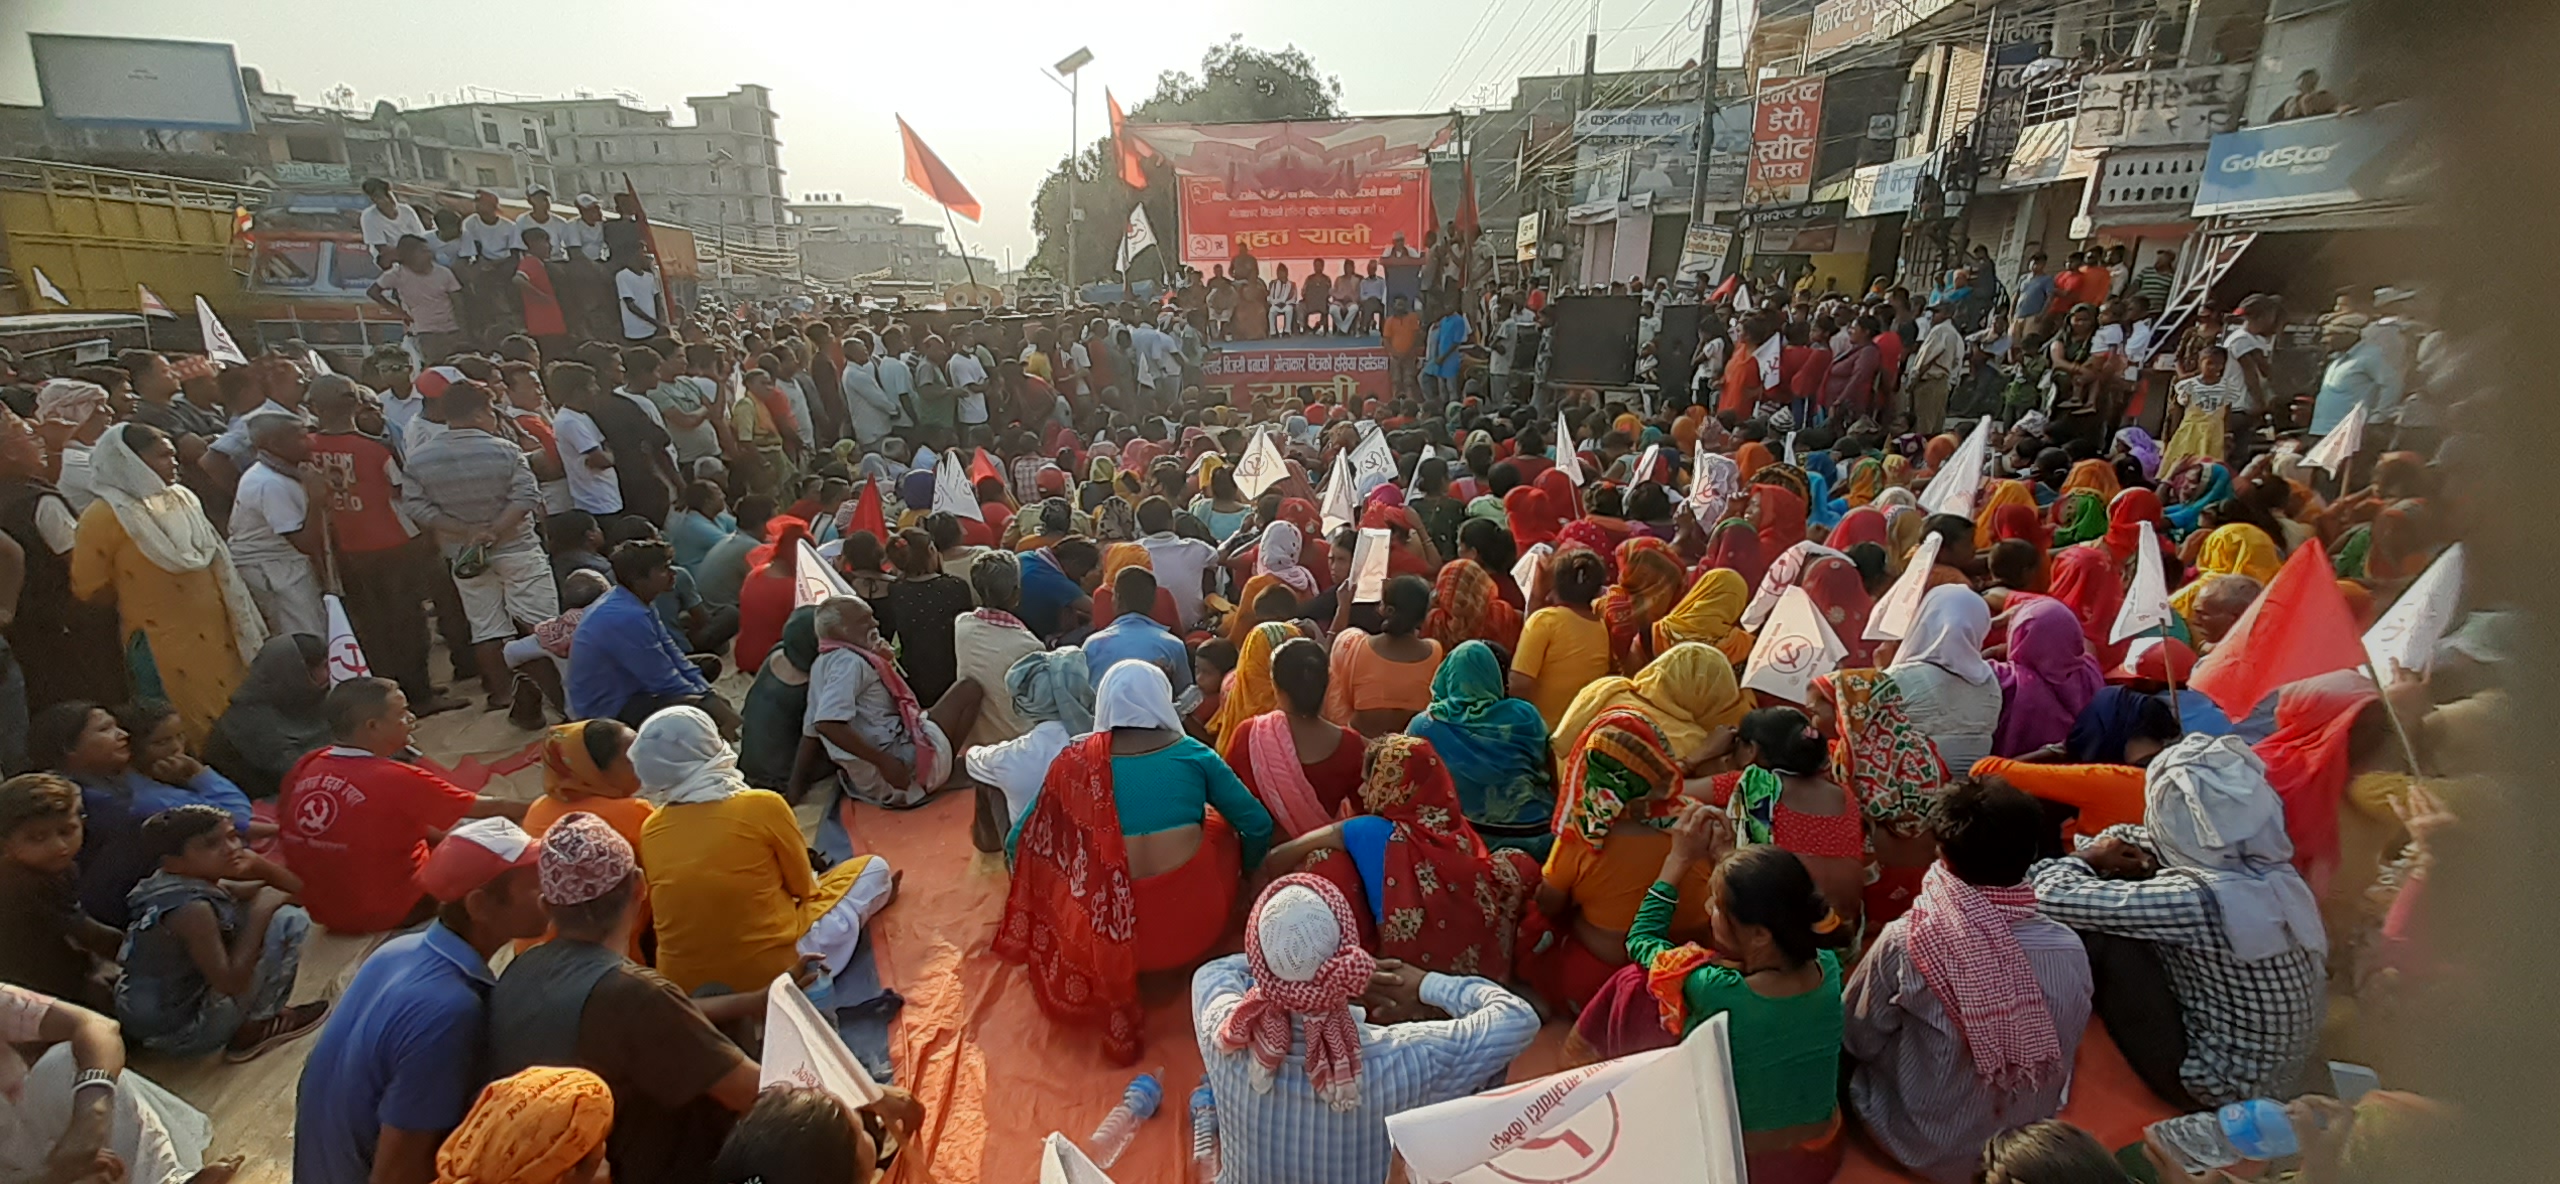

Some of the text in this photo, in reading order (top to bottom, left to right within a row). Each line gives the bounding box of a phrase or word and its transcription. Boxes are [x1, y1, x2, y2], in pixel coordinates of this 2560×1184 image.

[1650, 111, 1682, 127] स्टील
[1768, 106, 1806, 132] डेरी
[1756, 134, 1814, 164] स्वीट
